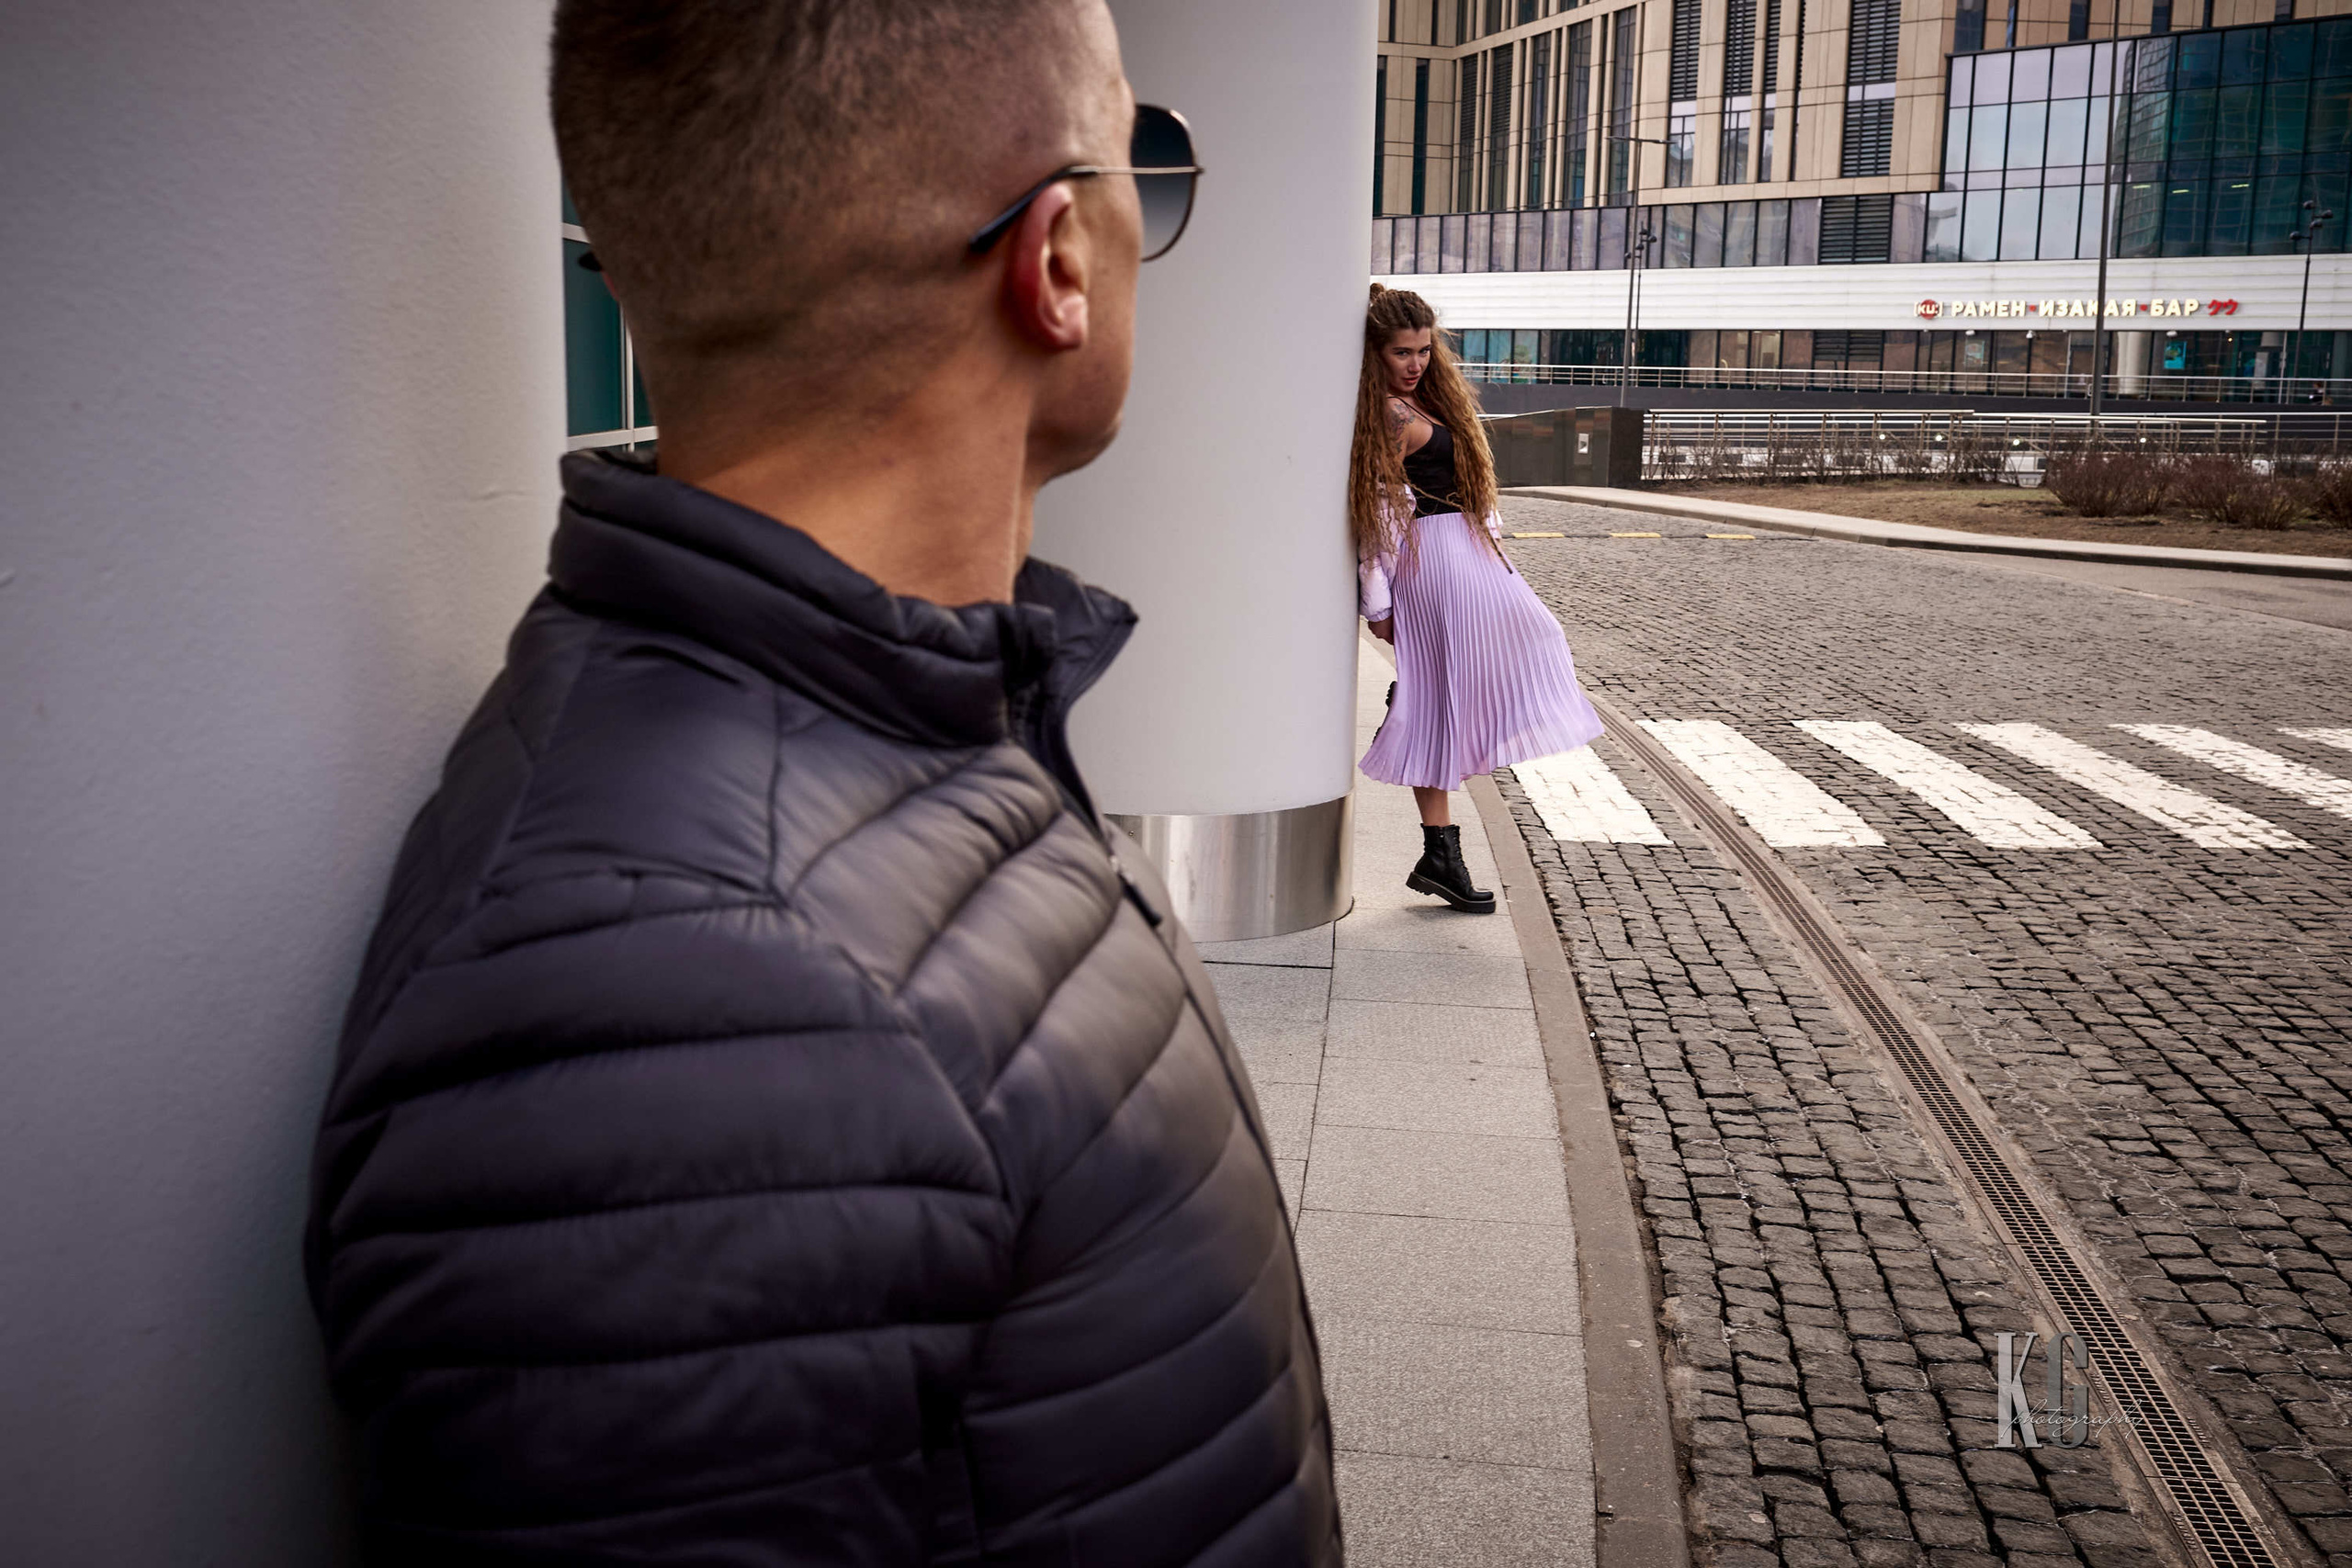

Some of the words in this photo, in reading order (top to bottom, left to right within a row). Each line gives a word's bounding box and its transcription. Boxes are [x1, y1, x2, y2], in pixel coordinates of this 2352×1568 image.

[1951, 299, 2026, 317] РАМЕН
[2039, 299, 2137, 317] ИЗАКАЯ
[2150, 299, 2199, 317] БАР
